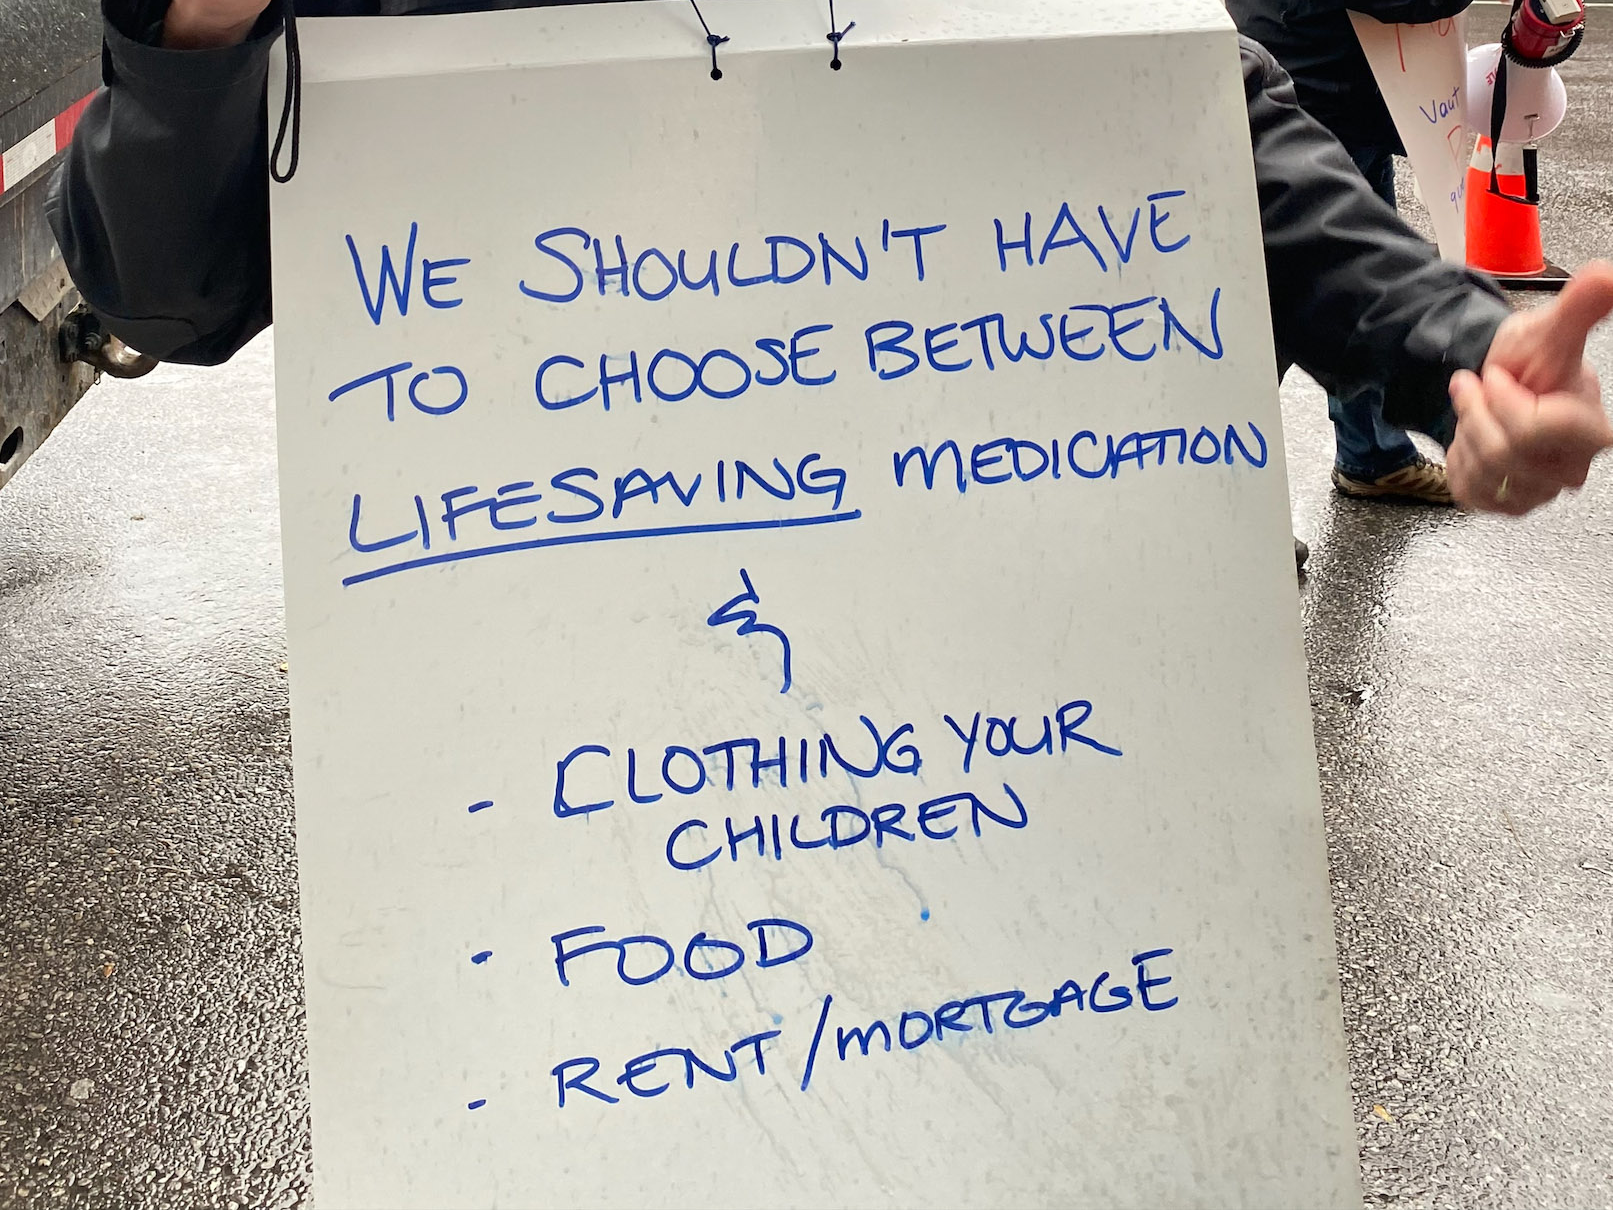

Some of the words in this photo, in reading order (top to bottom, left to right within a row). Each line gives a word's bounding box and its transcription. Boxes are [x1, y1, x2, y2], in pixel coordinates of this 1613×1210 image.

[1419, 86, 1460, 124] Vaut
[346, 222, 469, 325] WE
[519, 220, 946, 302] SHOULDN'T
[994, 191, 1190, 272] HAVE
[329, 362, 468, 421] TO
[536, 325, 837, 411] CHOOSE
[865, 288, 1223, 380] BETWEEN
[350, 454, 846, 552] LIFESAVING
[894, 423, 1267, 493] MEDICATION
[554, 716, 922, 818] CLOTHING
[944, 700, 1122, 773] YOUR
[666, 784, 1028, 870] CHILDREN
[552, 919, 813, 986] FOOD
